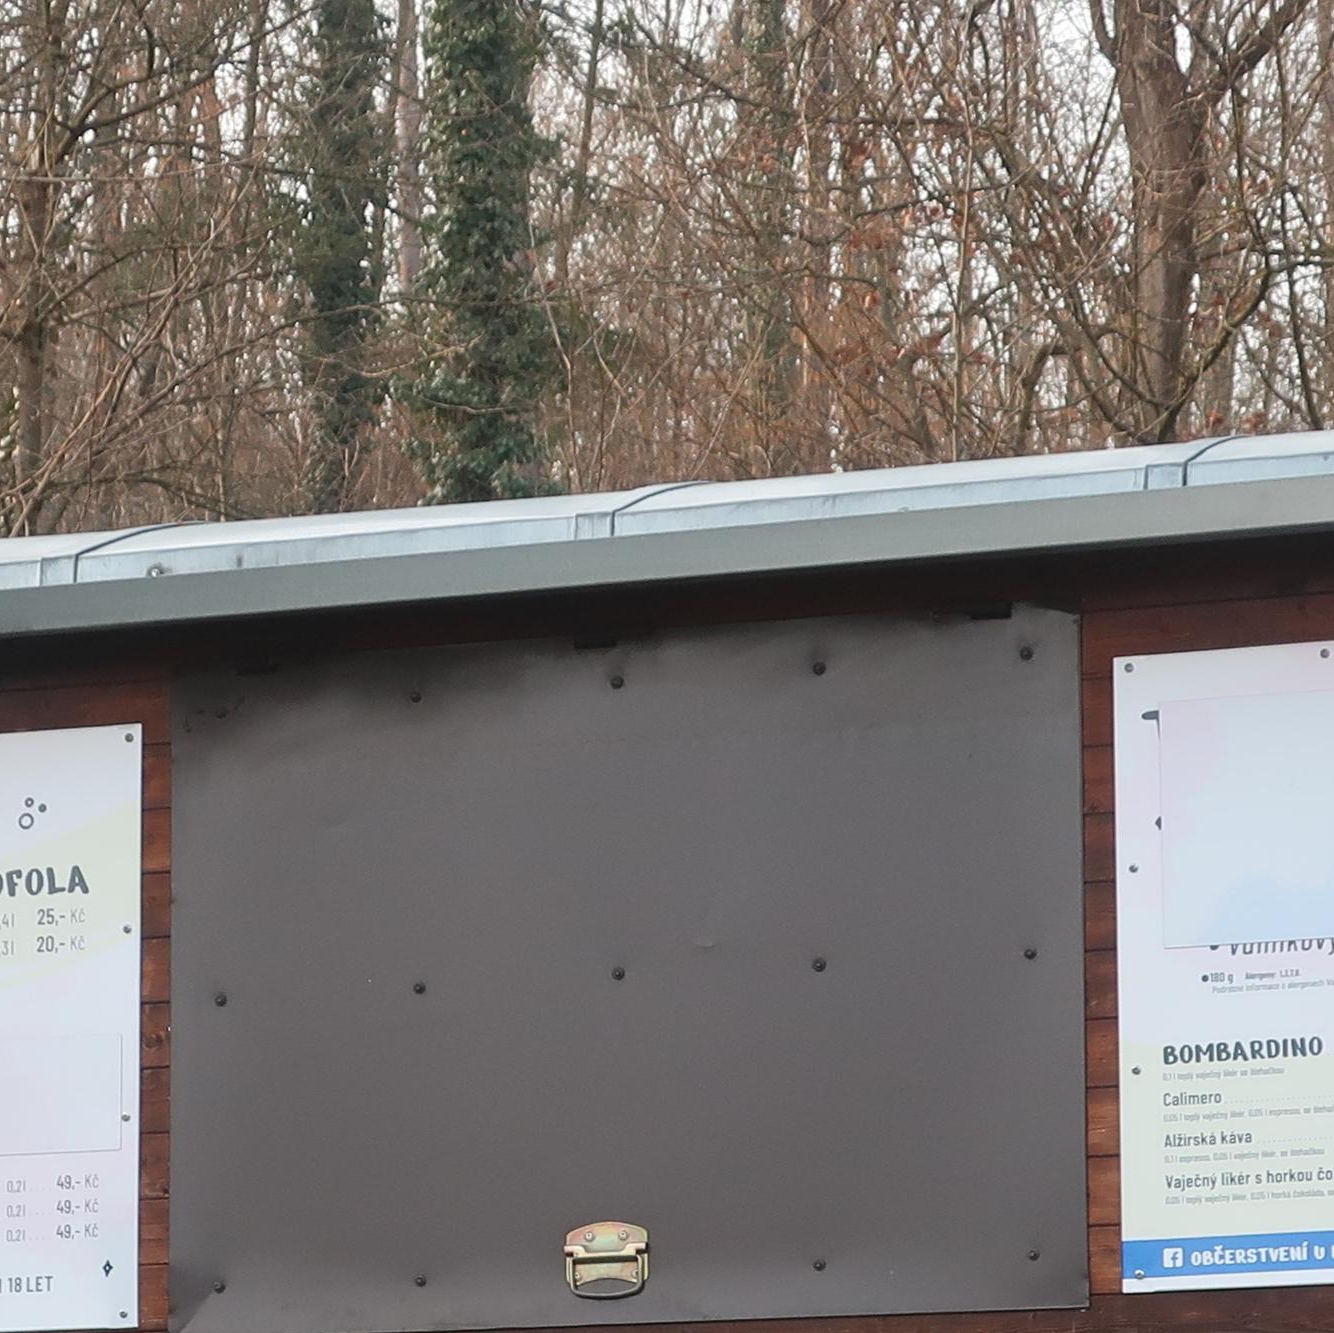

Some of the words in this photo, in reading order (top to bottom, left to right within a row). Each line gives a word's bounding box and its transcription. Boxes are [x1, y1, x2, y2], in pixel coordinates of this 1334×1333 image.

[37, 908, 65, 926] 25,-
[70, 908, 86, 923] Kč
[36, 935, 65, 954] 20,-
[69, 935, 85, 951] Kč
[1163, 1036, 1323, 1065] BOMBARDINO
[1163, 1092, 1222, 1107] Calimero
[1221, 1130, 1252, 1145] káva
[56, 1175, 81, 1191] 49,-
[84, 1174, 100, 1189] Kč
[1166, 1172, 1217, 1192] Vaječný
[1221, 1171, 1251, 1186] likér
[1266, 1168, 1313, 1184] horkou
[56, 1199, 81, 1215] 49,-
[84, 1198, 100, 1213] Kč
[56, 1224, 81, 1240] 49,-
[84, 1223, 99, 1238] Kč
[1190, 1241, 1309, 1267] OBČERSTVENÍ
[1313, 1243, 1325, 1261] U
[8, 1277, 22, 1293] 18
[26, 1275, 54, 1293] LET
